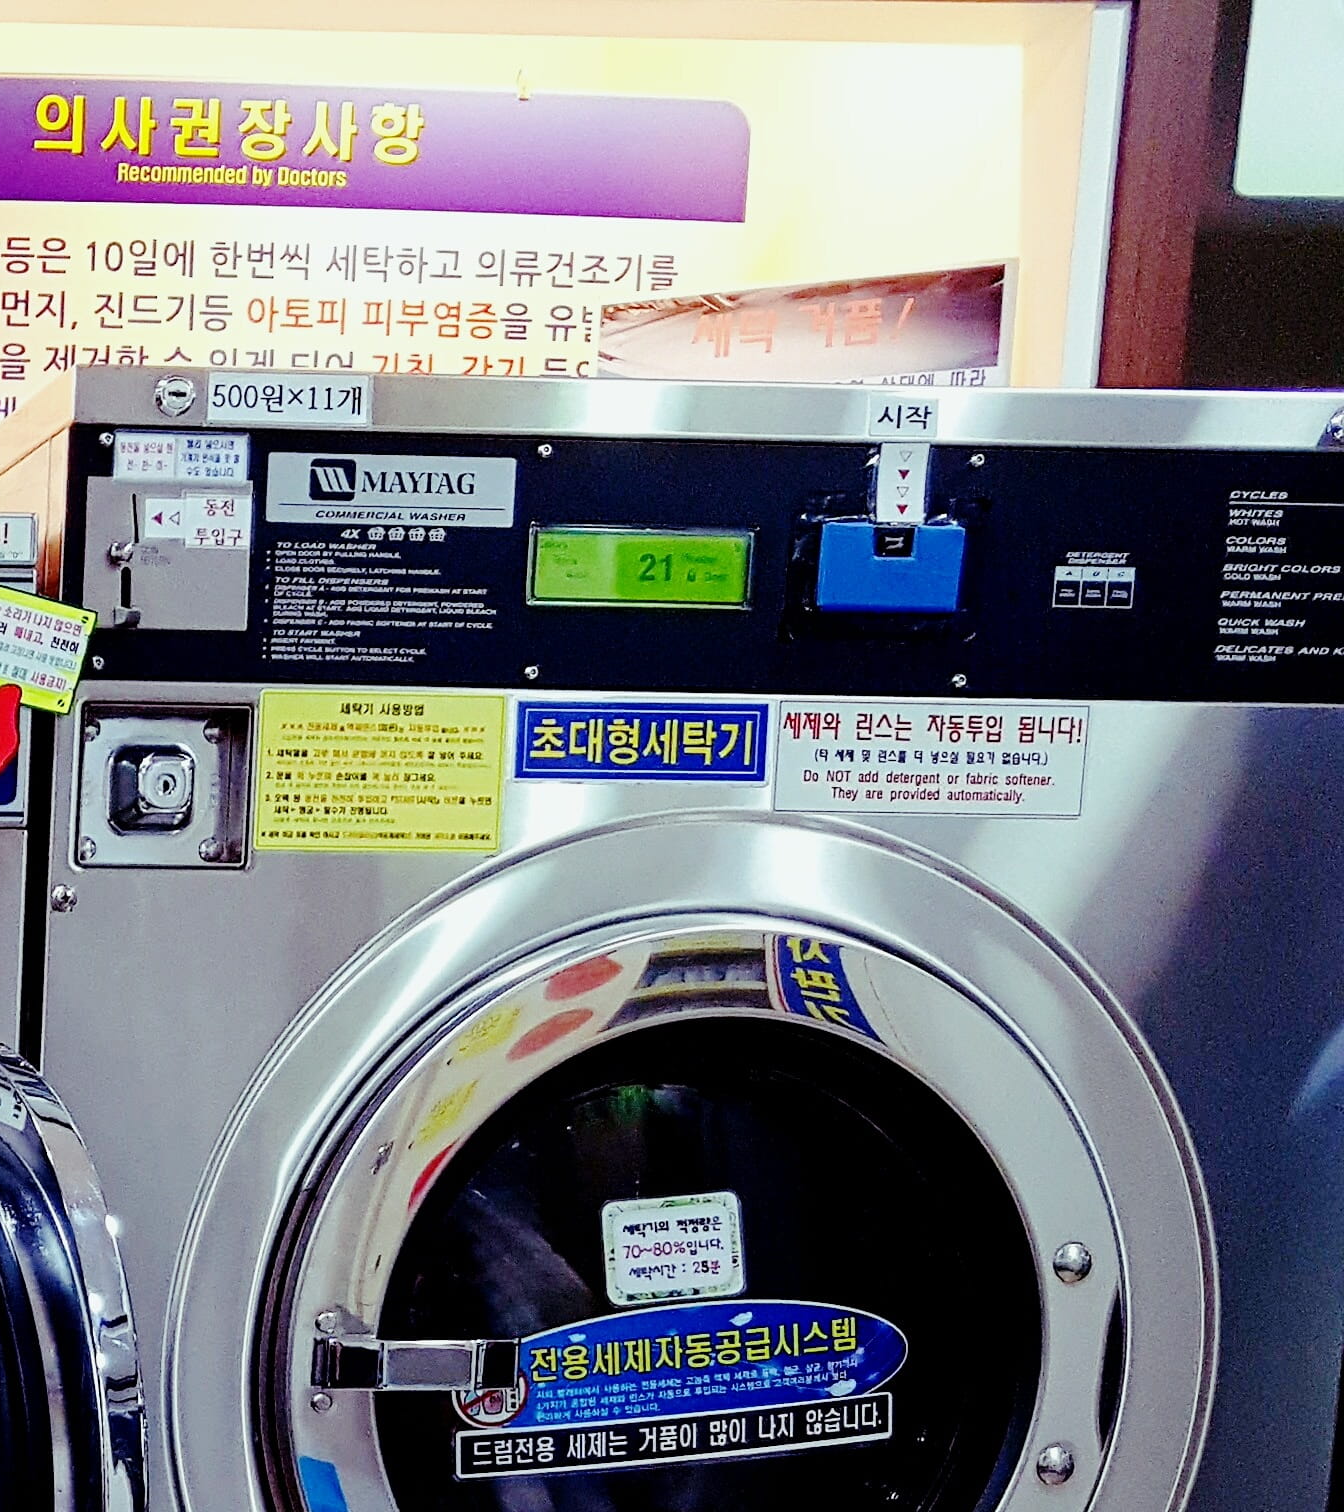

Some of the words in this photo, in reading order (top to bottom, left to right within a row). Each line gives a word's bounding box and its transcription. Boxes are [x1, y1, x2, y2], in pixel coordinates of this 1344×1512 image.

[33, 93, 426, 166] 의사권장사항
[117, 162, 248, 186] Recommended
[252, 164, 274, 189] by
[278, 165, 347, 188] Doctors
[86, 238, 195, 278] 10일에
[210, 241, 310, 281] 한번씩
[326, 245, 462, 284] 세탁하고
[476, 249, 679, 292] 의류건조기를
[1, 290, 79, 331] 먼지,
[94, 293, 233, 333] 진드기등
[247, 296, 346, 335] 아토피
[363, 299, 533, 342] 피부염증을
[879, 403, 933, 430] 시작
[361, 471, 475, 496] MAYTAG
[1229, 490, 1288, 500] CYCLES
[204, 499, 235, 517] 동전
[315, 510, 406, 520] COMMERCIAL
[410, 512, 466, 522] WASHER
[1228, 509, 1284, 518] WHITES
[194, 528, 244, 547] 투입구
[1226, 536, 1287, 545] COLORS
[639, 552, 673, 582] 21
[1223, 564, 1278, 572] BRIGHT
[1281, 565, 1342, 574] COLORS
[783, 712, 841, 740] 세제와
[856, 713, 911, 741] 린스는
[927, 714, 1003, 743] 자동투입
[1018, 716, 1082, 744] 됩니다!
[531, 717, 753, 767] 초대형세탁기
[530, 1316, 858, 1383] 전용세제자동공급시스템
[472, 1435, 555, 1466] 드럼전용
[567, 1429, 629, 1460] 세제는
[639, 1423, 699, 1453] 거품이
[710, 1418, 747, 1447] 많이
[759, 1412, 795, 1440] 나지
[806, 1403, 882, 1436] 않습니다.
